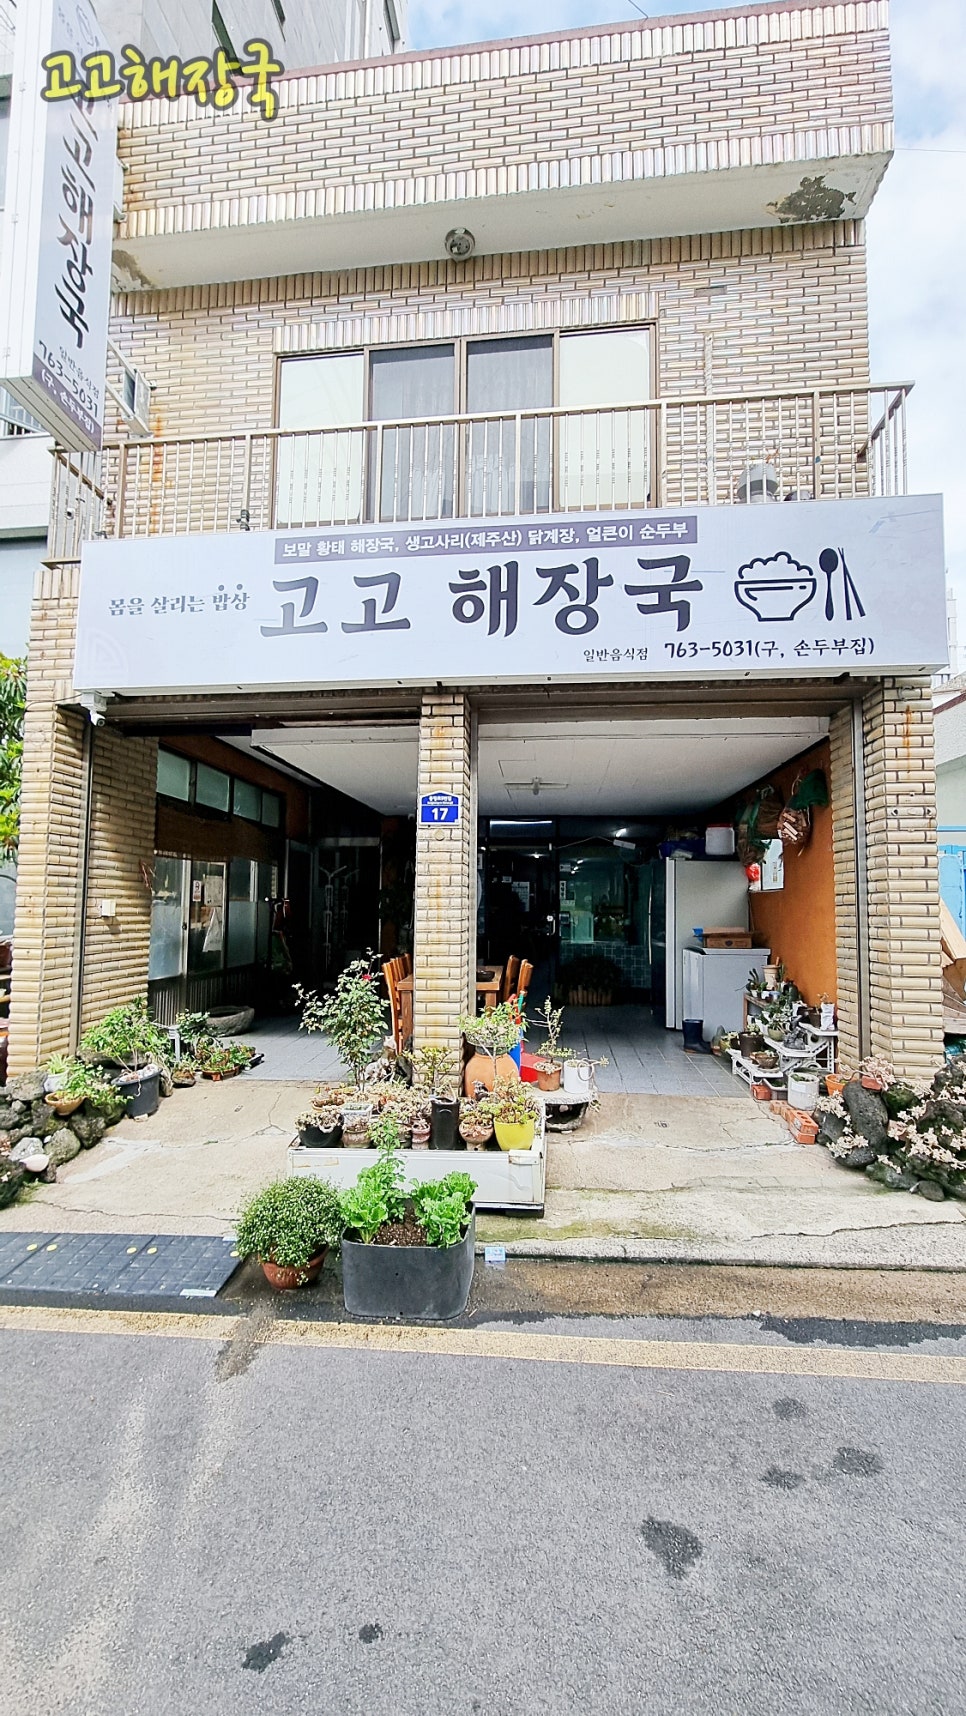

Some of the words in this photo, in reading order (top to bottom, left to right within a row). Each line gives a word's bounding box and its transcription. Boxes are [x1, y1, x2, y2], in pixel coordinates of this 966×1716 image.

[39, 339, 98, 418] 763-5031
[283, 542, 311, 557] 보말
[316, 540, 345, 556] 황태
[350, 537, 399, 553] 해장국,
[405, 532, 522, 551] 생고사리(제주산)
[528, 528, 580, 545] 닭계장,
[587, 526, 633, 542] 얼큰이
[640, 522, 688, 539] 순두부
[108, 597, 144, 616] 몸을
[151, 595, 205, 614] 살리는
[212, 589, 250, 612] 밥상
[583, 647, 648, 662] 일반음식점
[664, 640, 785, 659] 763-5031(구,
[793, 637, 875, 658] 손두부집)
[431, 807, 449, 821] 17
